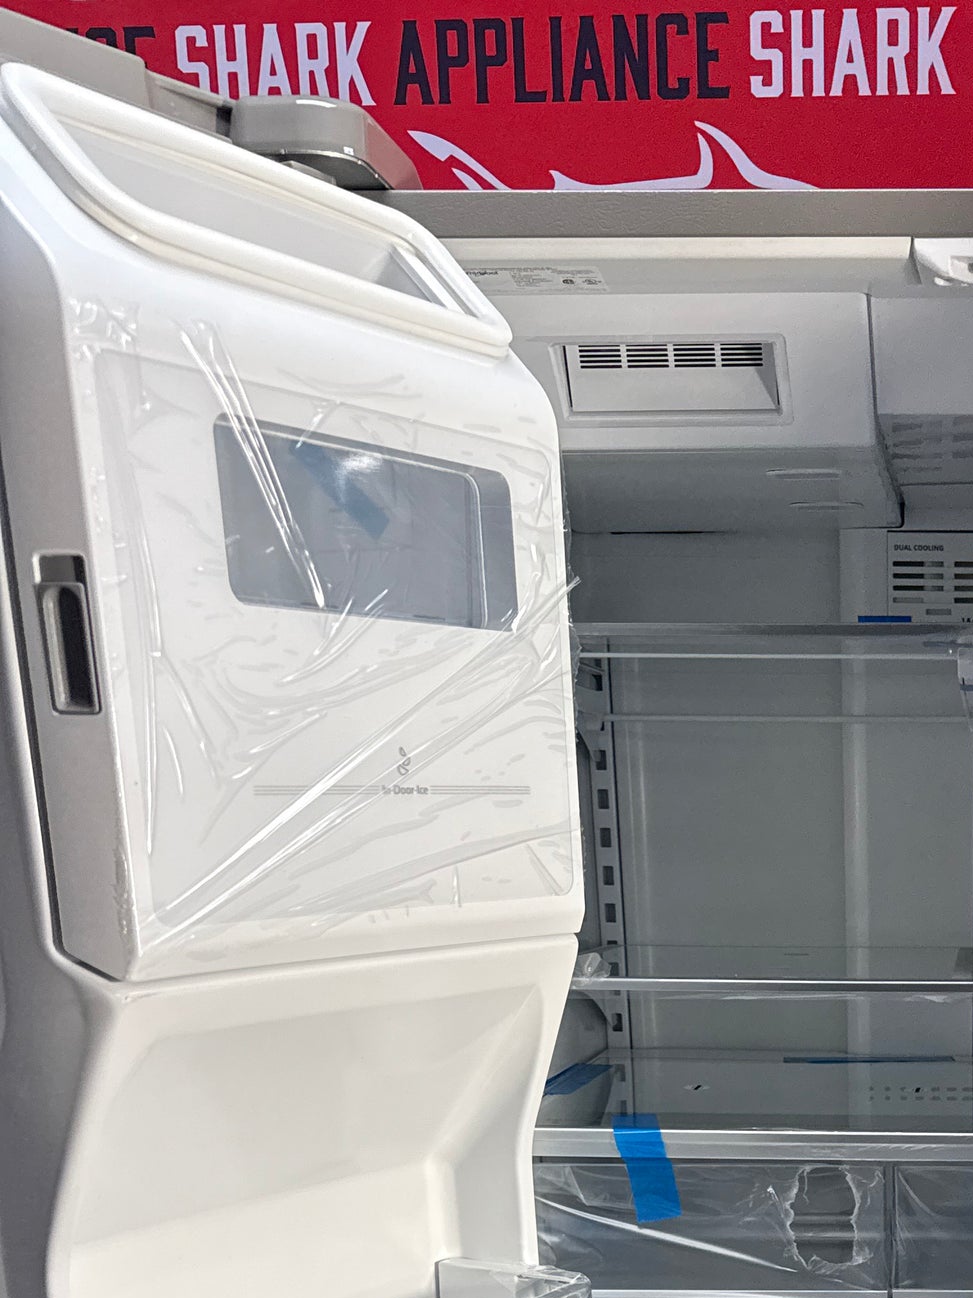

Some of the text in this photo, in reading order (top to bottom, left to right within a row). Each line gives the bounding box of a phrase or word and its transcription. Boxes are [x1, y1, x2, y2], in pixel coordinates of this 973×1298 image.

[175, 21, 377, 106] SHARK
[394, 12, 731, 105] APPLIANCE
[749, 7, 958, 98] SHARK
